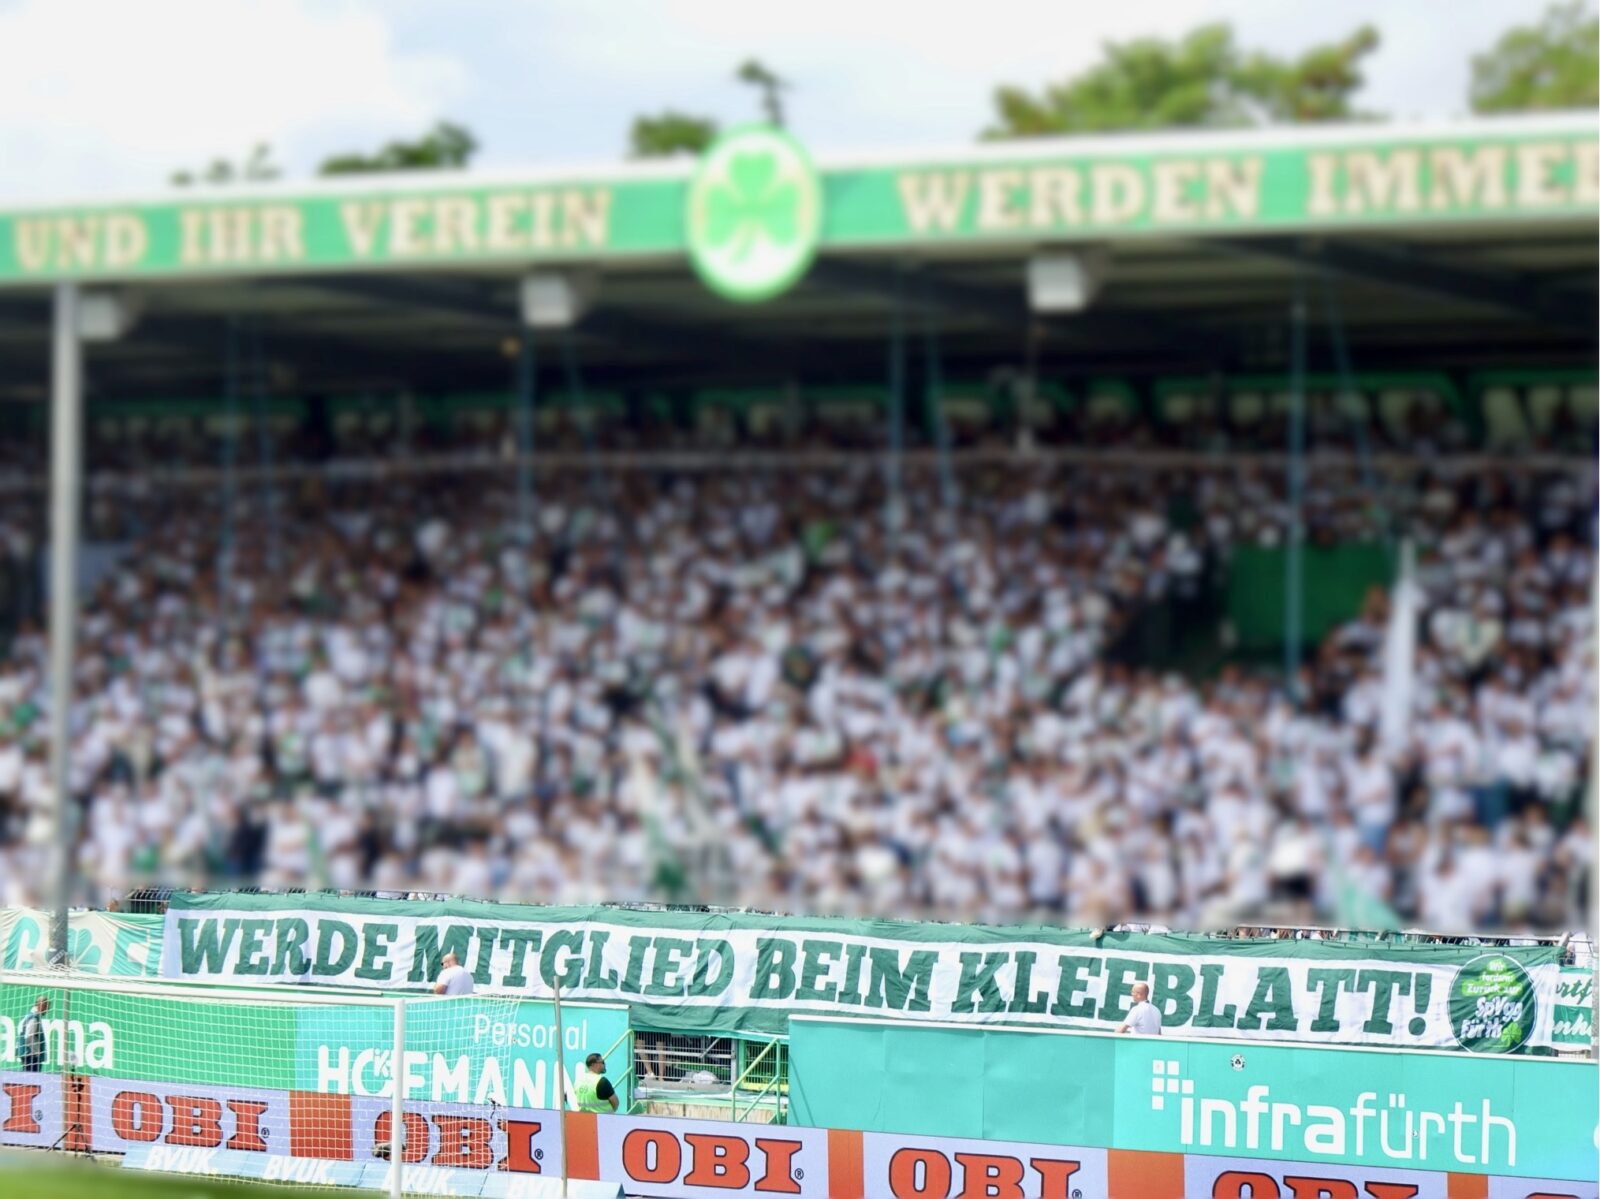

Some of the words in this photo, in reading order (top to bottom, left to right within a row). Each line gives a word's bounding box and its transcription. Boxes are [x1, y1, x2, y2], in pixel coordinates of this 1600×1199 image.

[15, 212, 149, 270] UND
[179, 204, 306, 264] IHR
[341, 188, 613, 257] VEREIN
[897, 155, 1264, 234] WERDEN
[177, 917, 400, 982] WERDE
[407, 923, 735, 999] MITGLIED
[749, 937, 940, 1013] BEIM
[950, 949, 1433, 1037] KLEEBLATT!
[1475, 997, 1523, 1022] SpVgg
[1460, 1018, 1502, 1039] Fürth
[1180, 1079, 1517, 1168] infrafürth
